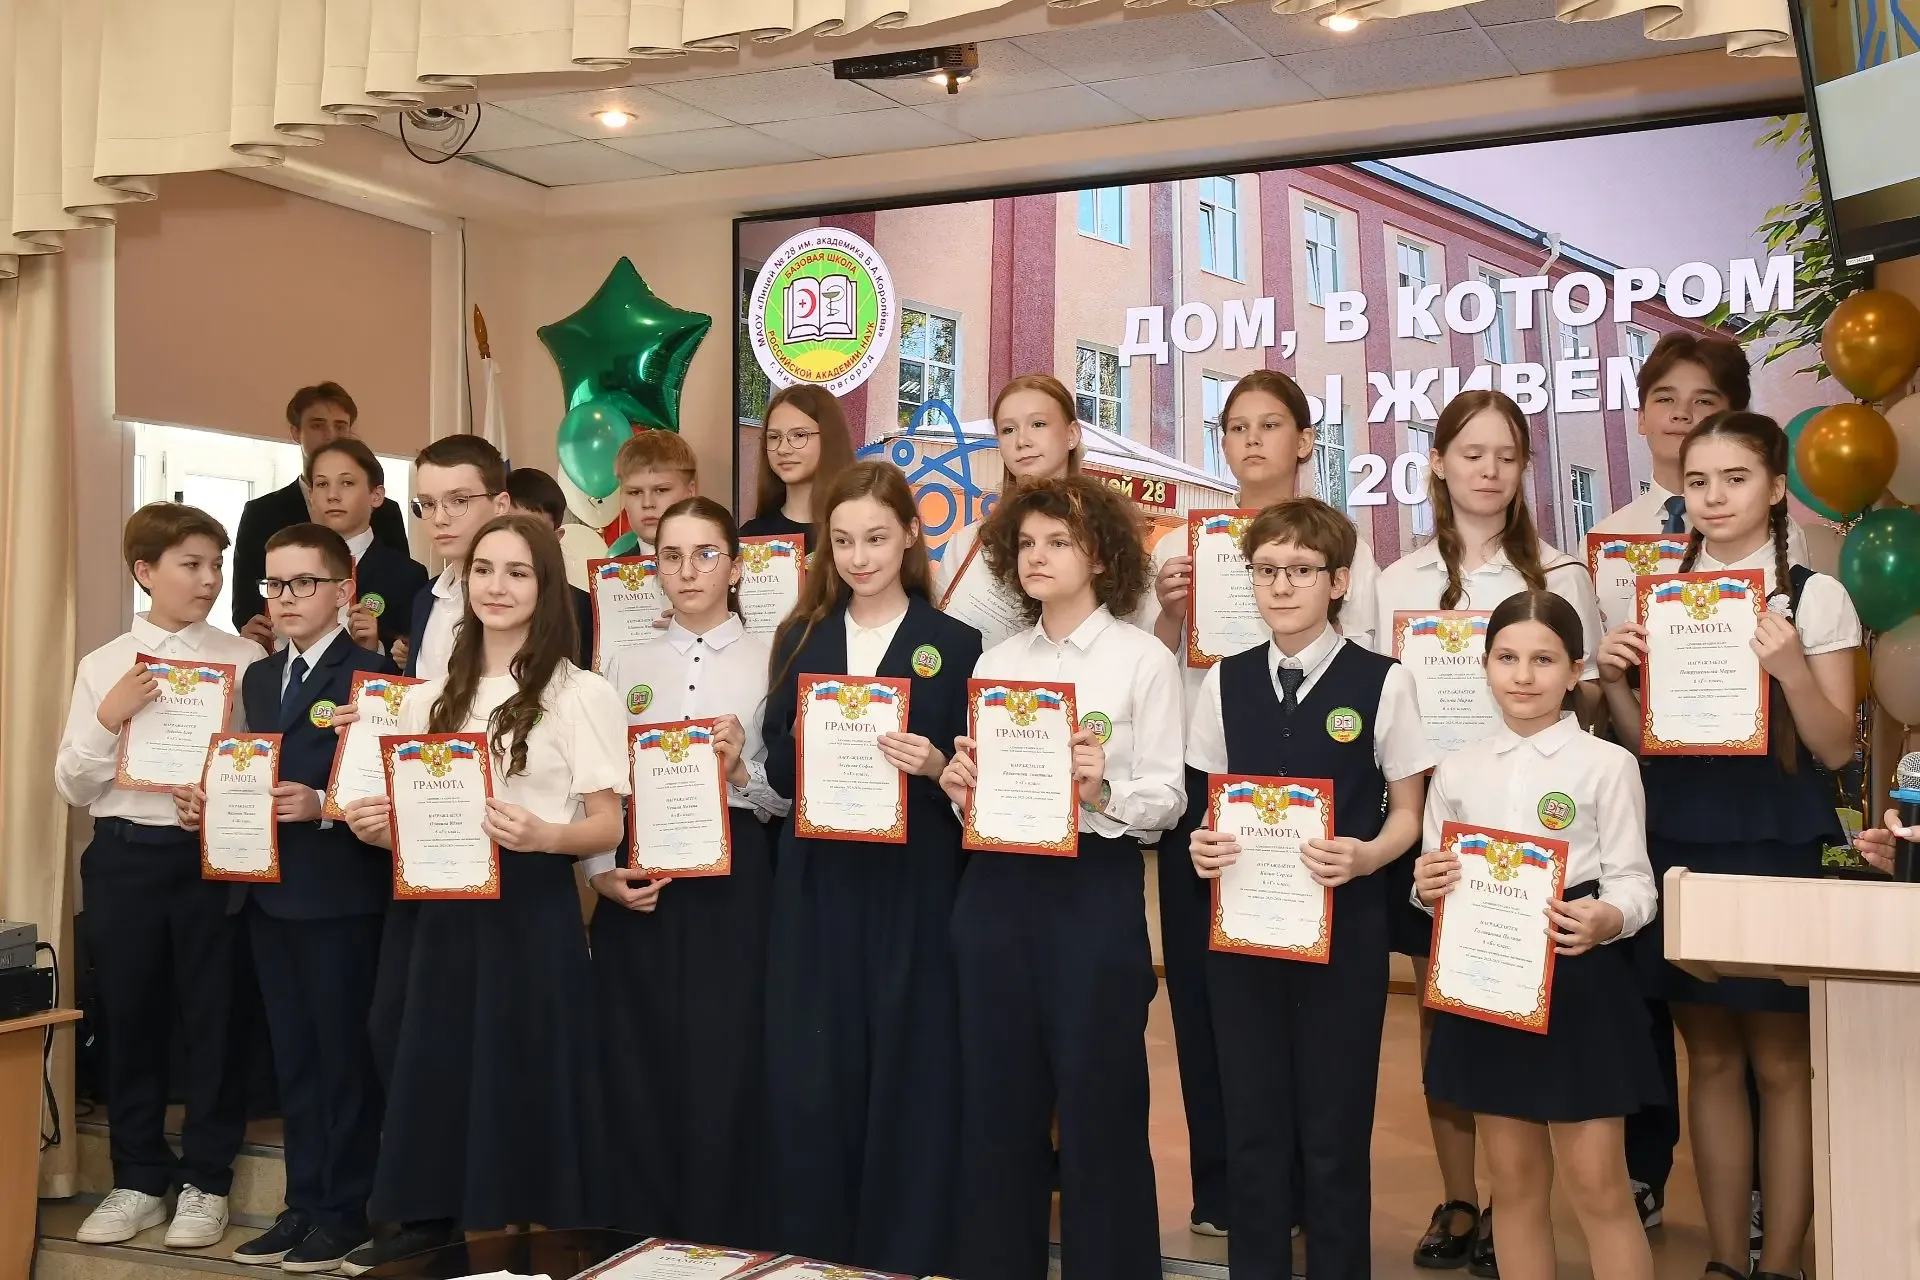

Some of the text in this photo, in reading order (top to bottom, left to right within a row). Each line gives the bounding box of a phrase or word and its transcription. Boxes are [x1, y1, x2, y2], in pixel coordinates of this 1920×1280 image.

[798, 241, 814, 251] им.
[816, 237, 865, 259] академика
[785, 247, 796, 259] 28
[774, 259, 784, 269] №
[785, 253, 857, 279] БАЗОВАЯ ШКОЛА
[758, 271, 776, 310] «Лицей
[1118, 255, 1796, 366] ДОМ, В КОТОРОМ
[755, 314, 766, 347] МАОУ
[768, 322, 875, 379] РОССИЙСКОЙ АКАДЕМИИ НАУК
[770, 361, 775, 369] г.
[822, 354, 875, 391] Новгород
[1142, 480, 1166, 503] 28
[613, 592, 655, 602] ГРАМОТА
[1669, 622, 1733, 635] ГРАМОТА
[1424, 655, 1481, 666] ГРАМОТА
[825, 721, 877, 733] ГРАМОТА
[996, 728, 1050, 740] ГРАМОТА
[652, 764, 700, 777] ГРАМОТА
[220, 773, 257, 783] ГРАМОТА
[413, 780, 465, 790] ГРАМОТА
[1240, 826, 1301, 839] ГРАМОТА
[1470, 879, 1528, 900] ГРАМОТА
